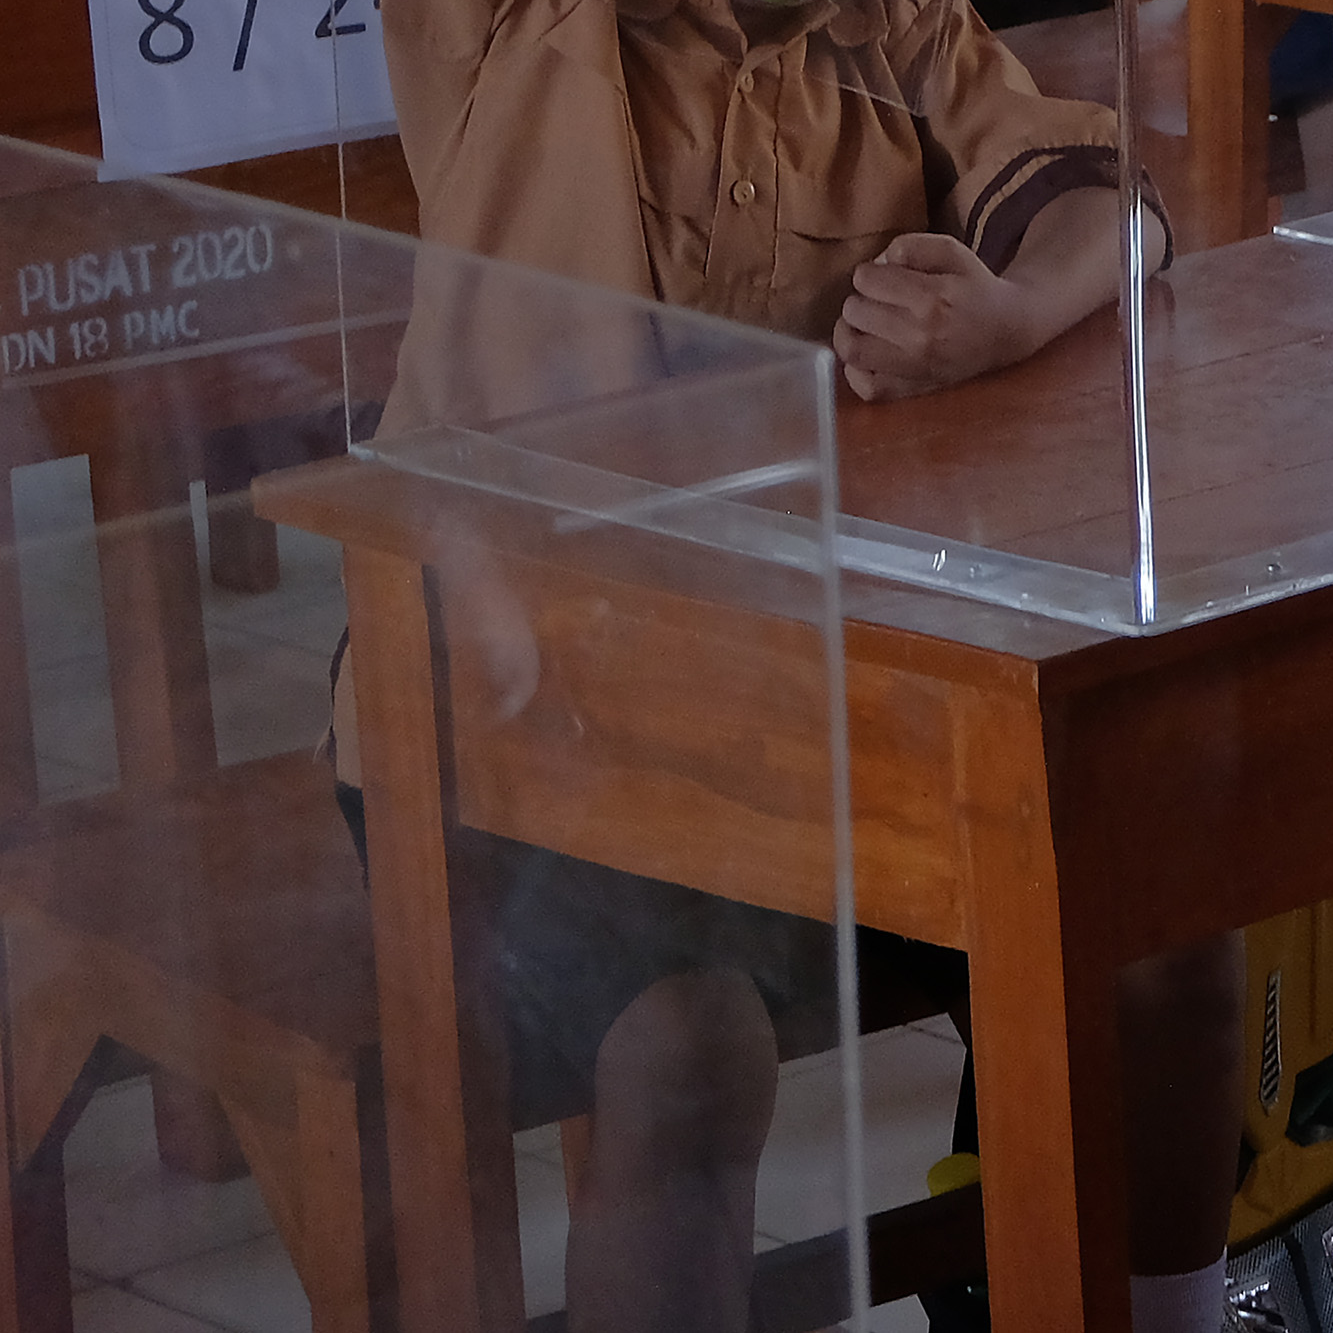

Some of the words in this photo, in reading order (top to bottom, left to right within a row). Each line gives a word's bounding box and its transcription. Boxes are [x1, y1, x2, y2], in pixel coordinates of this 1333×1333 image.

[17, 242, 157, 316] PUSAT
[170, 222, 273, 288] 2020
[0, 326, 57, 374] DN
[69, 316, 110, 361] 18
[123, 299, 200, 351] PMC
